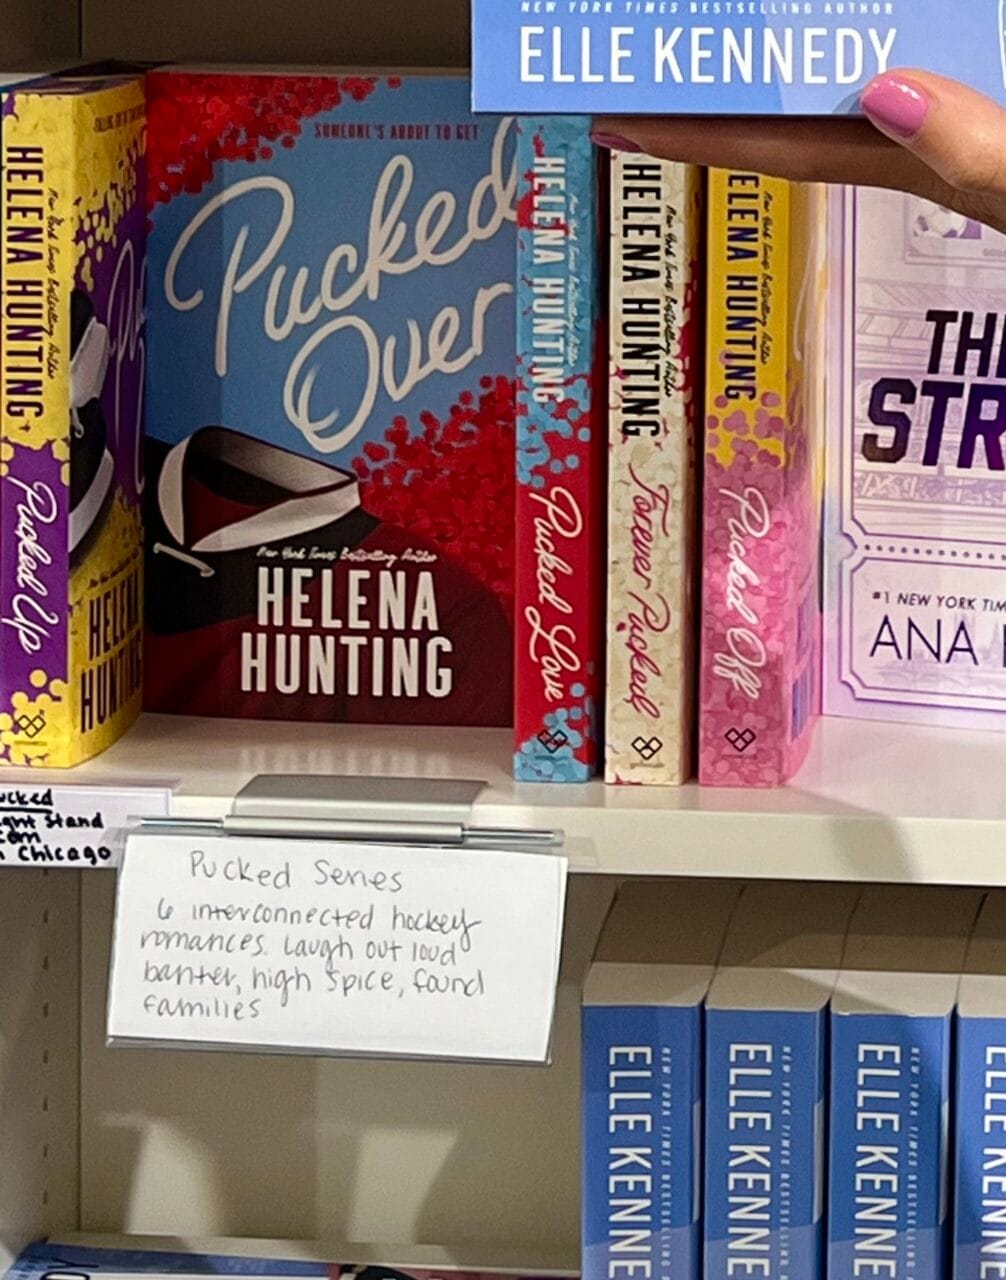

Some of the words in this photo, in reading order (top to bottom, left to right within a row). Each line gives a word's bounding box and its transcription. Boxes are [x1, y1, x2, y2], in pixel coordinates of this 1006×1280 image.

[521, 0, 557, 13] NEW
[568, 1, 613, 13] YORK
[625, 1, 679, 14] TIMES
[690, 1, 812, 15] BESTSELLING
[824, 2, 895, 15] AUTHOR
[520, 26, 635, 84] ELLE
[654, 27, 897, 85] KENNEDY
[6, 145, 44, 264] HELENA
[164, 116, 518, 377] Pucked
[533, 156, 566, 266] HELENA
[622, 163, 662, 283] HELENA
[5, 279, 44, 418] HUNTING
[283, 281, 514, 454] Over
[532, 277, 565, 404] HUNTING
[621, 297, 661, 437] HUNTING
[724, 274, 758, 401] HUNTING
[6, 476, 58, 596] Pucked
[529, 486, 582, 614] Pucked
[628, 462, 670, 590] Forever
[719, 487, 770, 625] Pucked
[0, 591, 59, 654] Up
[257, 567, 439, 631] HELENA
[869, 614, 978, 666] ANA
[872, 590, 889, 605] #1
[897, 592, 931, 608] NEW
[936, 593, 977, 612] YORK
[241, 633, 453, 698] HUNTING
[525, 606, 581, 702] Love
[624, 591, 671, 719] Pucked
[713, 627, 768, 700] Off
[18, 844, 111, 865] Chicago
[44, 811, 104, 829] Stand
[190, 850, 290, 890] Pucked
[314, 858, 403, 893] Series
[156, 898, 175, 921] 6
[192, 900, 374, 932] interconnected
[392, 899, 482, 952] hockey
[365, 937, 403, 959] out
[411, 937, 457, 965] loud
[142, 994, 263, 1020] families
[143, 962, 241, 995] banter,
[252, 968, 312, 1007] high
[413, 970, 486, 997] found
[609, 1046, 652, 1133] ELLE
